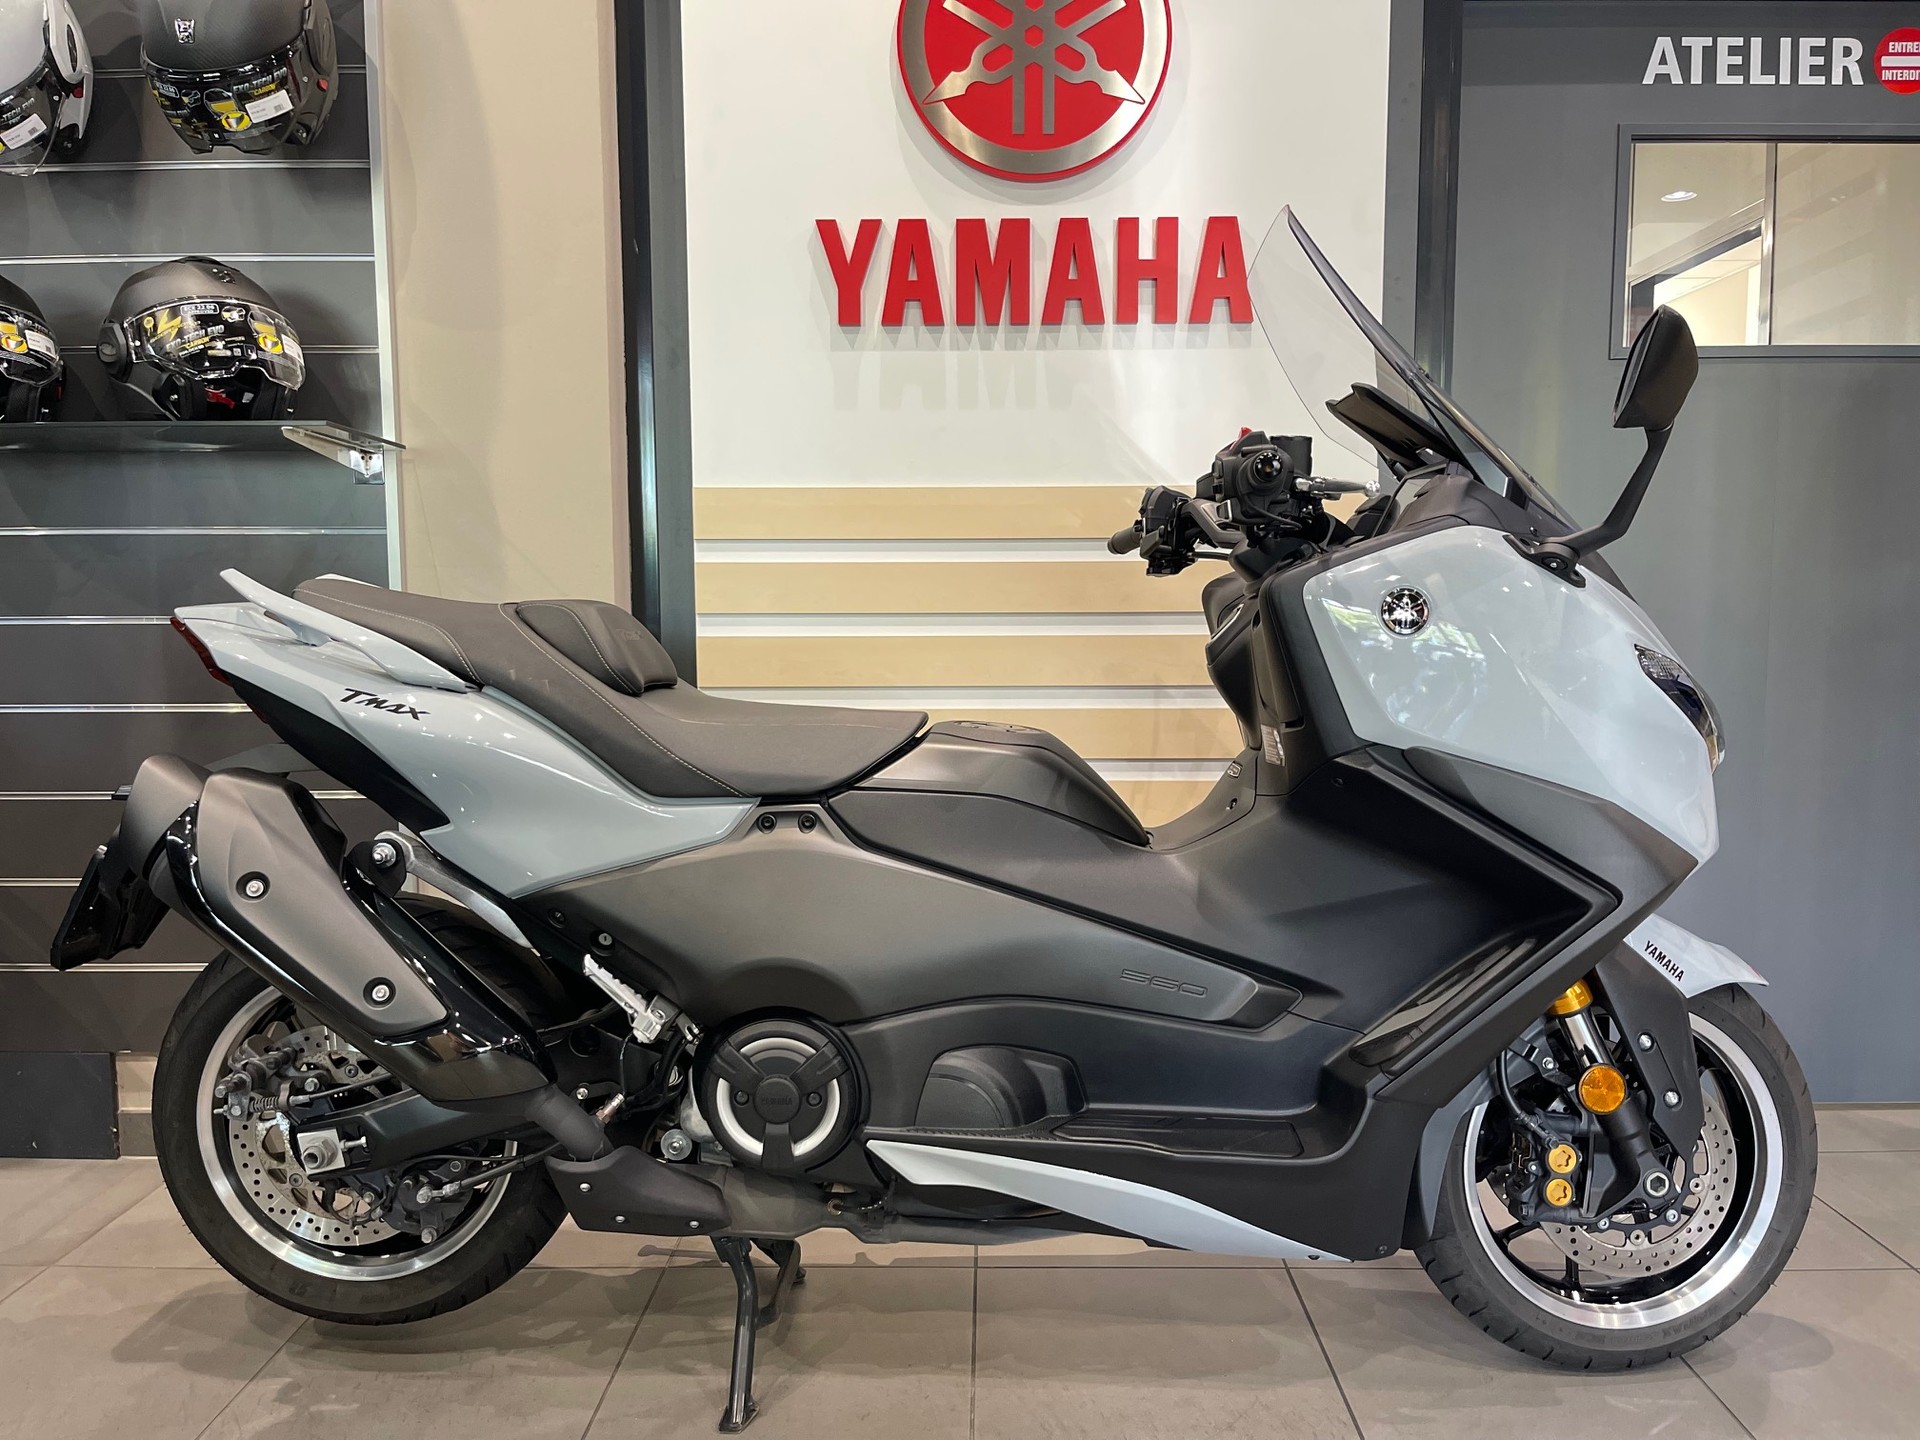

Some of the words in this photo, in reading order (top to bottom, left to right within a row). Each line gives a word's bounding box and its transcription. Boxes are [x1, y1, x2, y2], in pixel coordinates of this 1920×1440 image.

[1641, 36, 1864, 86] ATELIER
[1888, 41, 1920, 53] ENTRE
[1881, 69, 1920, 81] INTERDI
[815, 216, 1254, 327] YAMAHA
[207, 324, 225, 336] EVO
[340, 688, 431, 721] TMAX
[1644, 940, 1685, 982] YAMAHA
[1120, 968, 1208, 998] 560
